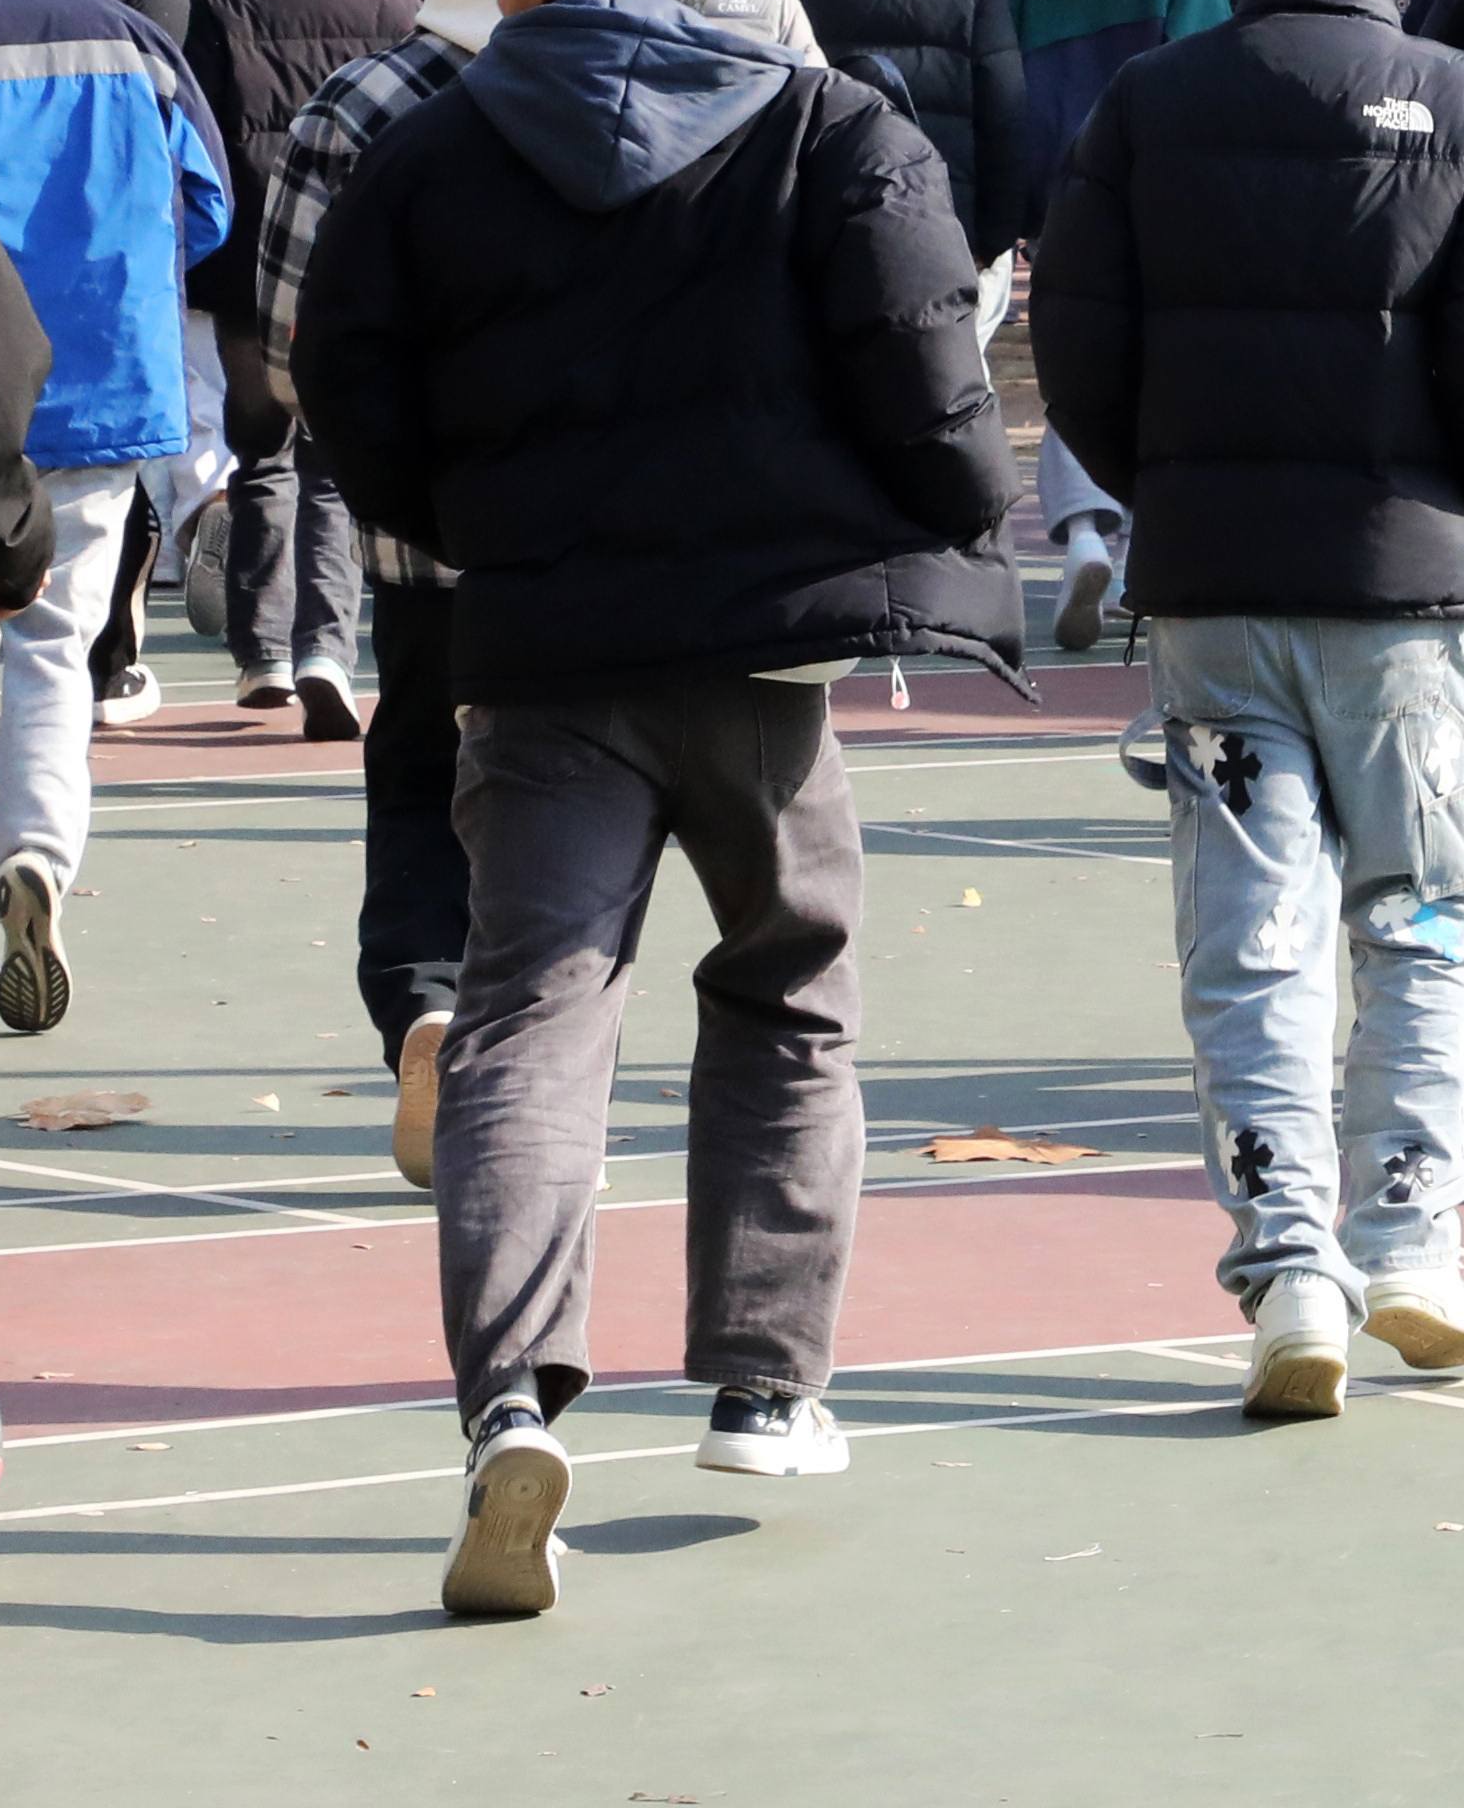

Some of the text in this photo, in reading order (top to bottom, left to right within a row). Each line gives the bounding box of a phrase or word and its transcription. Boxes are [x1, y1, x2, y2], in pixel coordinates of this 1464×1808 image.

[717, 2, 759, 13] CAMEL
[1382, 96, 1410, 112] THE
[1362, 104, 1410, 122] NORTH
[1375, 115, 1410, 131] FACE
